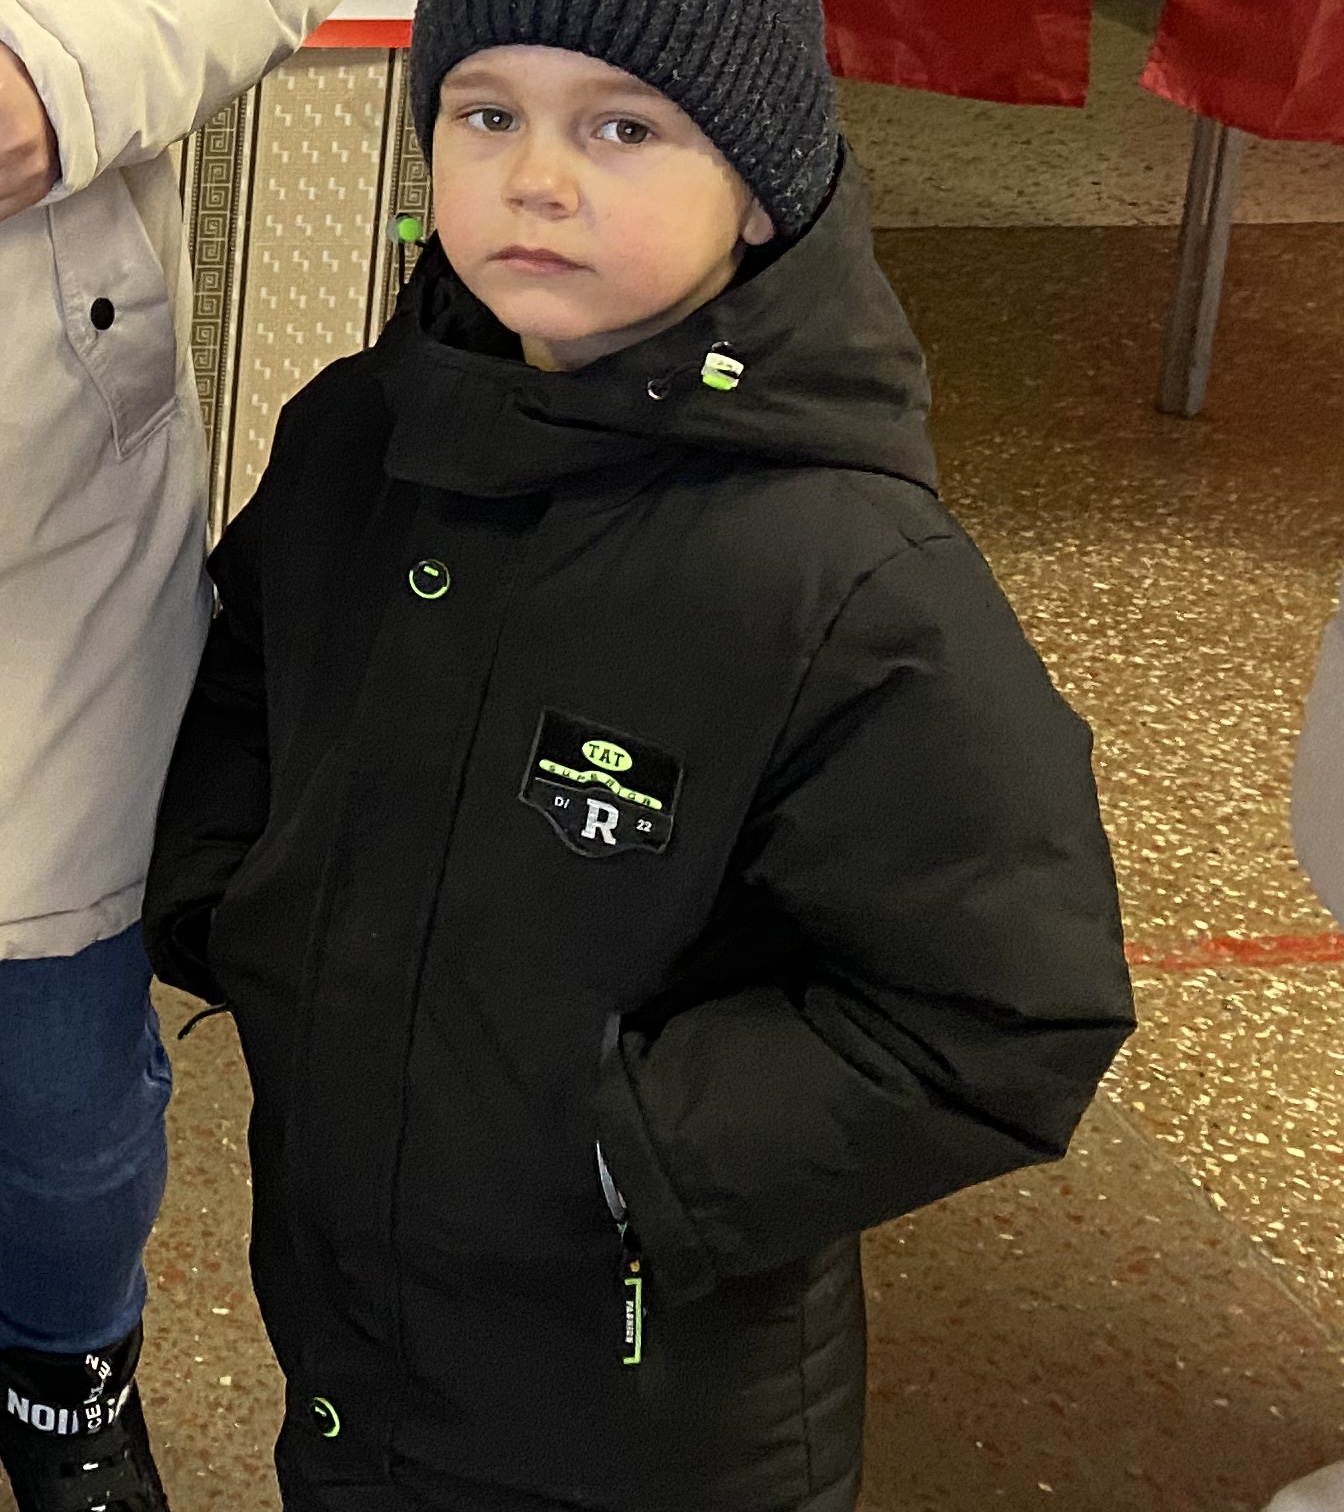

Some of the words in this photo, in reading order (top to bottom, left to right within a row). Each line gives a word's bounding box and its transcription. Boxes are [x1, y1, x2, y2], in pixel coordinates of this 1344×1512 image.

[588, 743, 625, 767] TAT
[581, 798, 620, 845] R
[636, 818, 653, 833] 22
